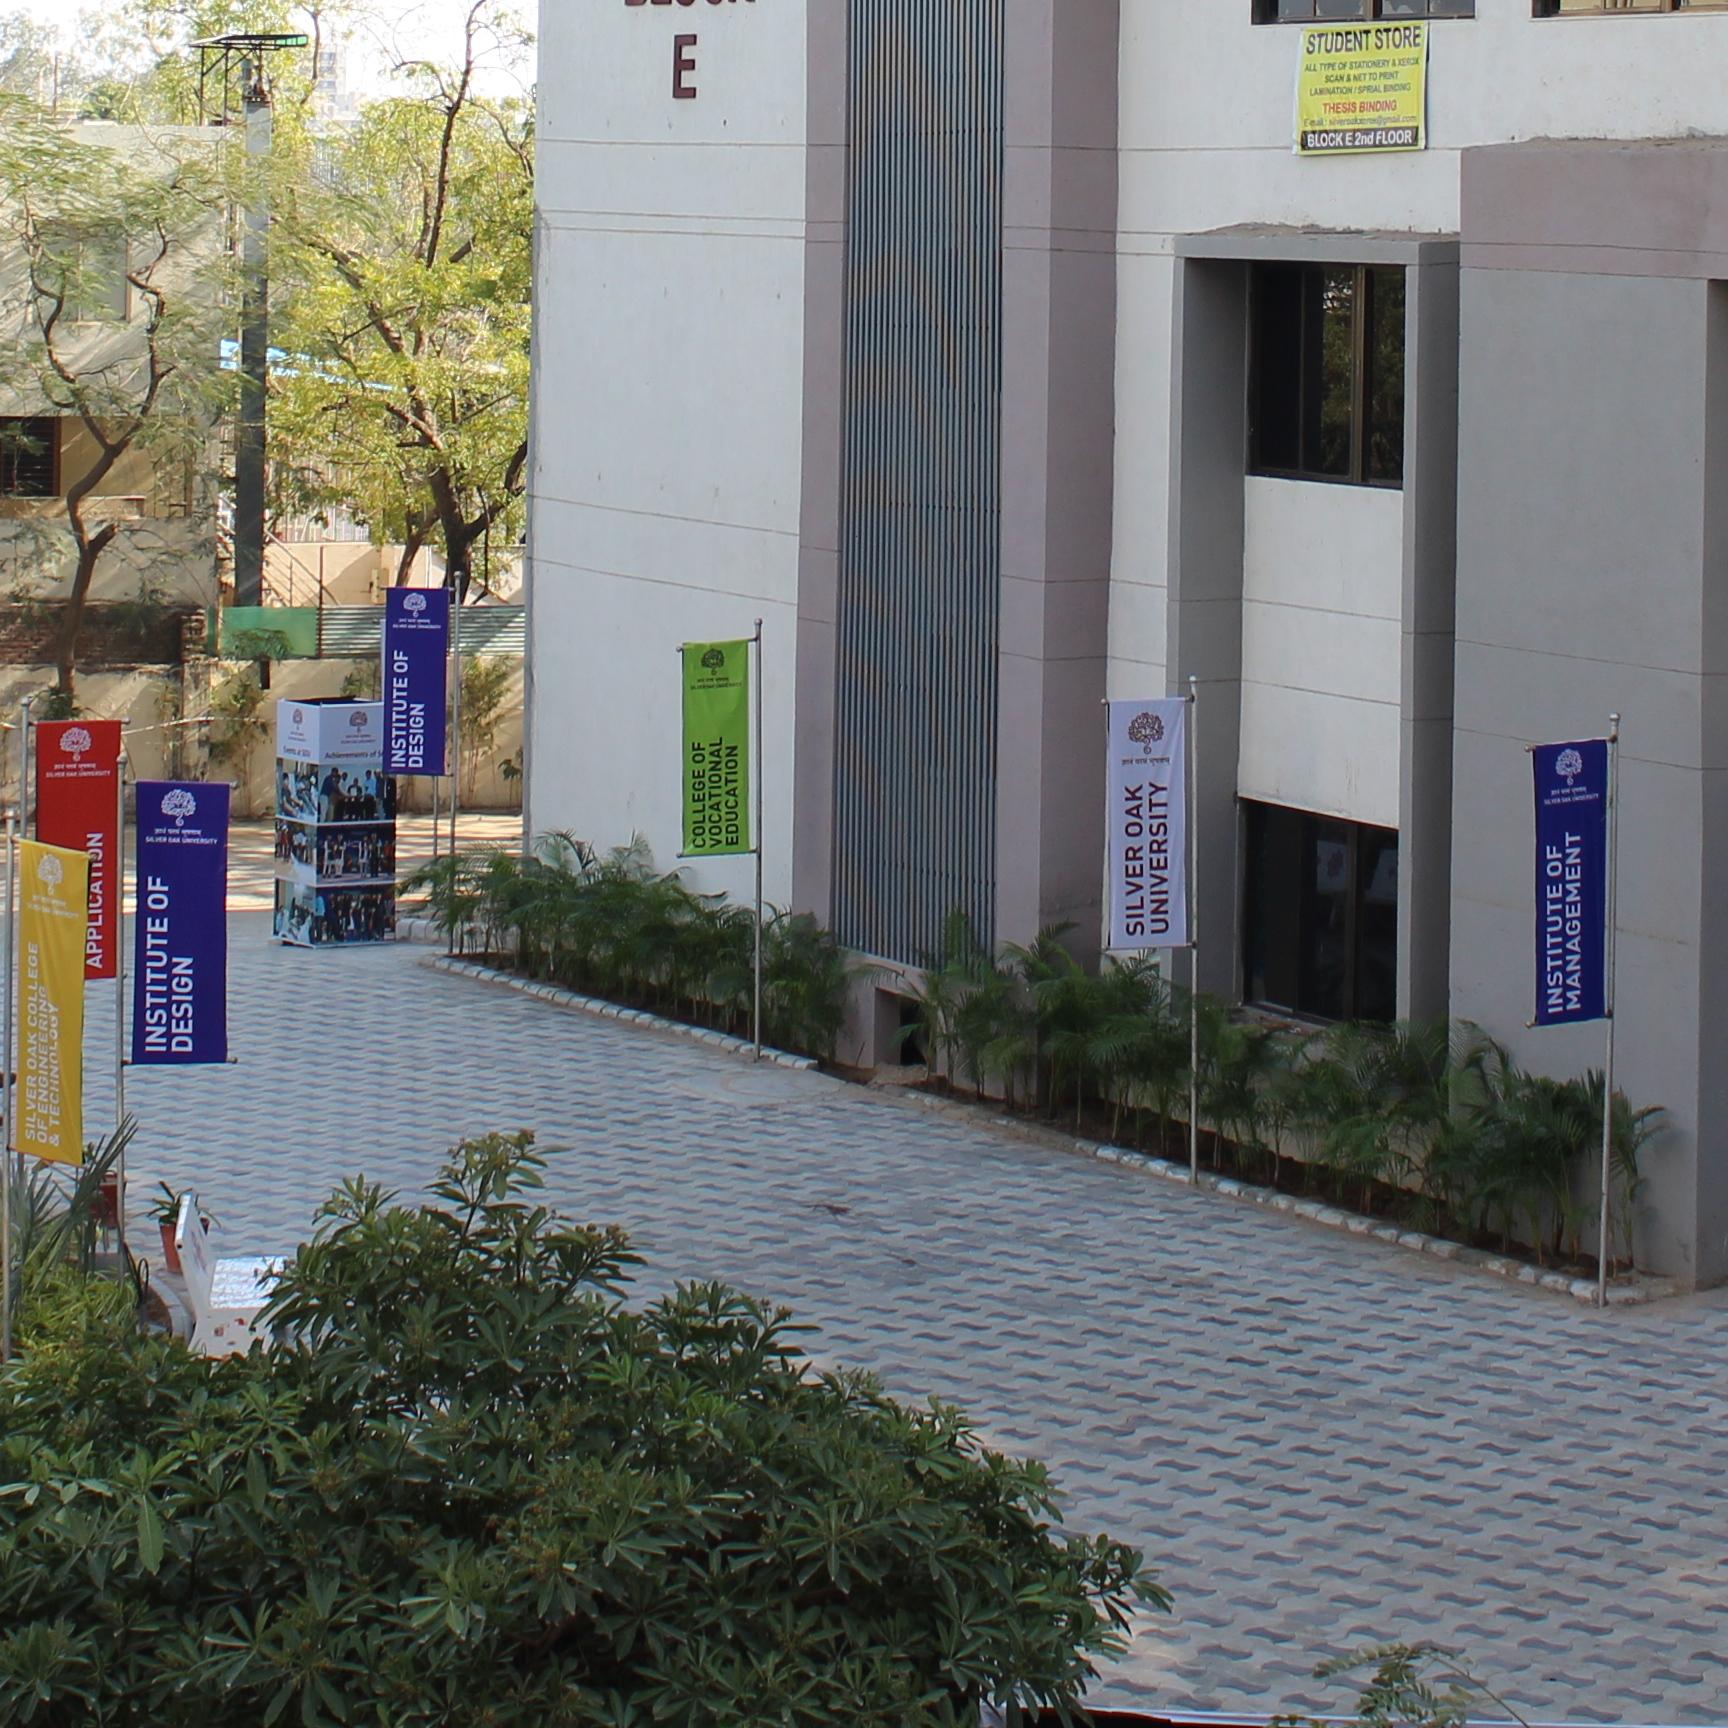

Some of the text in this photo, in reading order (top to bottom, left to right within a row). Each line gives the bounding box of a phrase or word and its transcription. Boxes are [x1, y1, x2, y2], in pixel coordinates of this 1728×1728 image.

[672, 34, 697, 99] E
[1305, 64, 1317, 72] ALL
[1319, 62, 1336, 70] TYPE
[1338, 62, 1347, 70] OF
[1306, 26, 1421, 54] STUDENT STORE
[1325, 74, 1344, 83] SCAN
[1353, 73, 1367, 81] NET
[1307, 130, 1412, 147] BLOCK E 2nd FLOOR
[1310, 87, 1352, 96] LAMINATION
[1323, 100, 1397, 114] THESIS BINDING
[391, 650, 409, 768] INSTITUTE OF
[408, 703, 425, 768] DESIGN
[692, 742, 706, 849] COLLEGE OF
[708, 737, 723, 848] VOCATIONAL
[725, 745, 739, 846] EDUCATION
[1124, 784, 1145, 936] SILVER OAK
[1149, 781, 1169, 934] UNIVERSITY
[145, 876, 169, 1052] INSTITUTE OF
[1546, 845, 1563, 1014] INSTITUTE OF
[1565, 832, 1581, 1011] MANAGEMENT
[25, 942, 39, 1140] SILVER OAK COLLEGE
[171, 957, 194, 1052] DESIGN
[37, 1114, 48, 1143] OF
[48, 1134, 60, 1146] &
